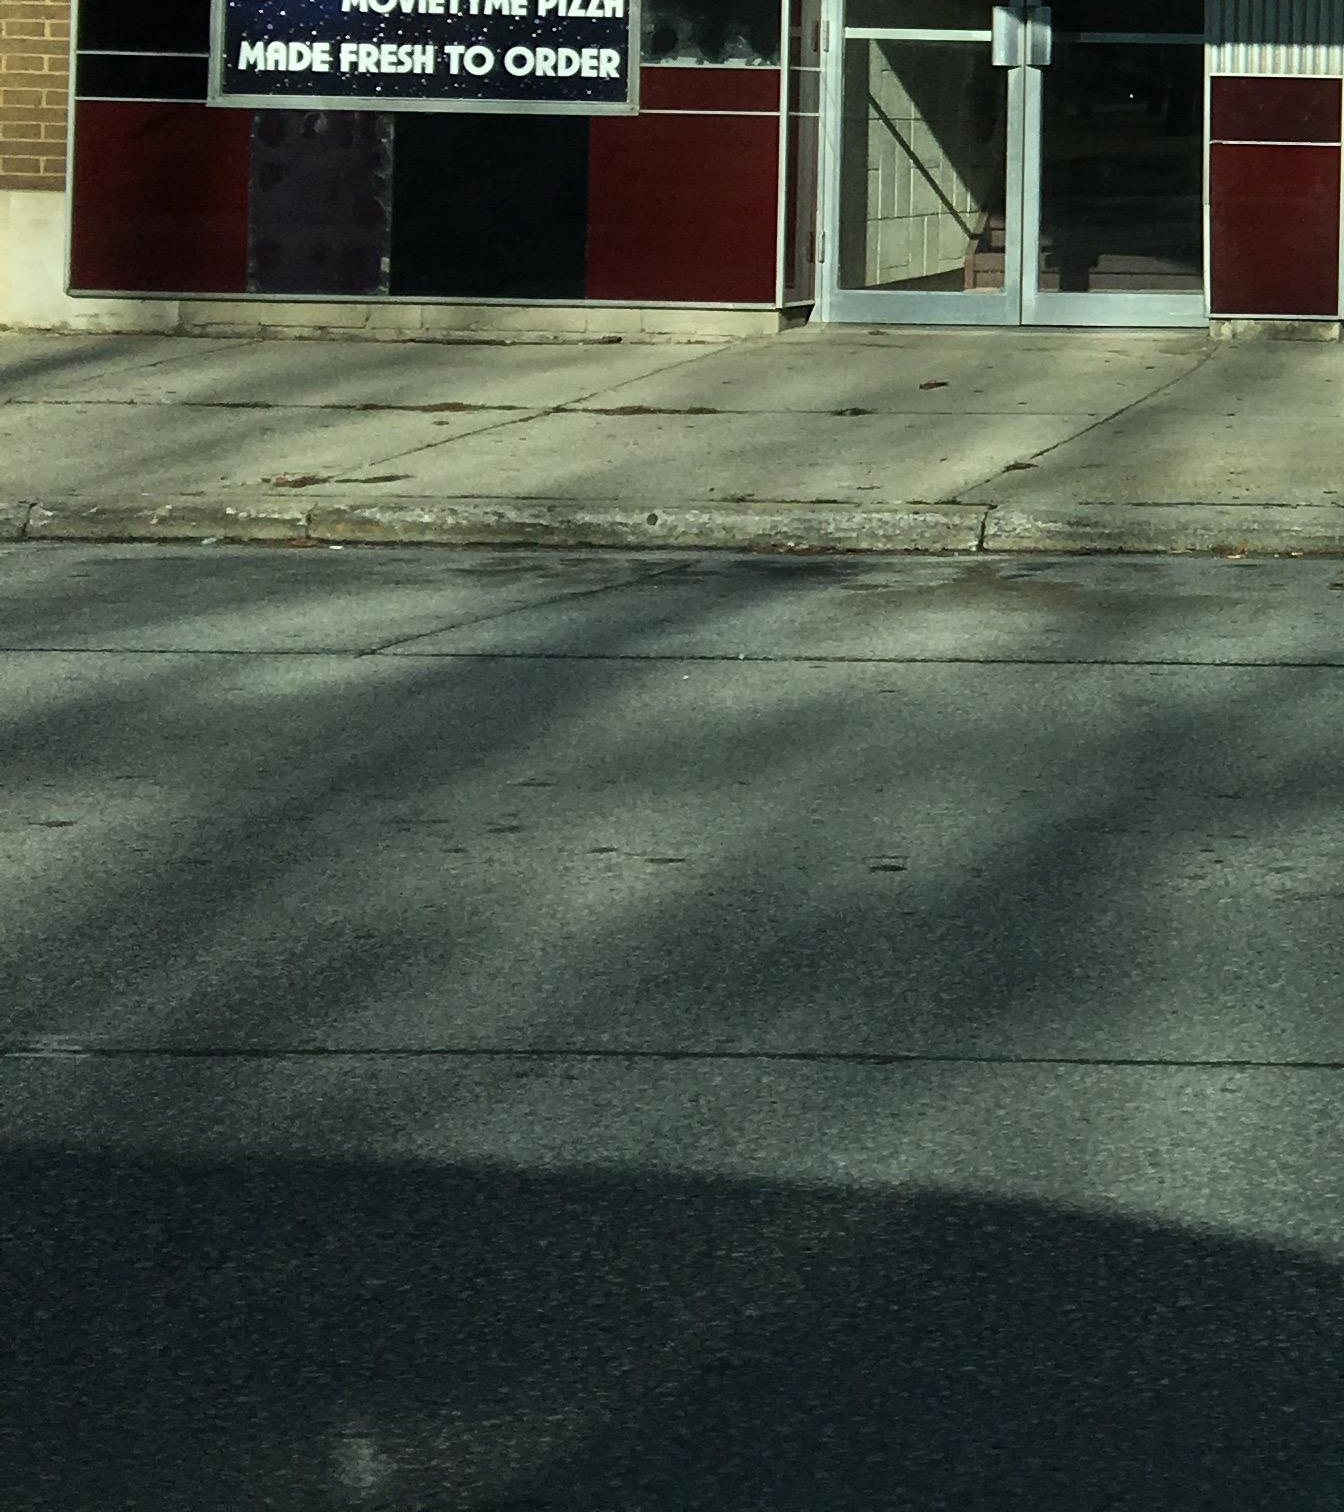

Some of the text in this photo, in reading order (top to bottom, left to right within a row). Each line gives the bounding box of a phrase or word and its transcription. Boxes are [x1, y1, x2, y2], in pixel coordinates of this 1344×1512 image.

[238, 41, 621, 79] MADE FRESH TO ORDER
